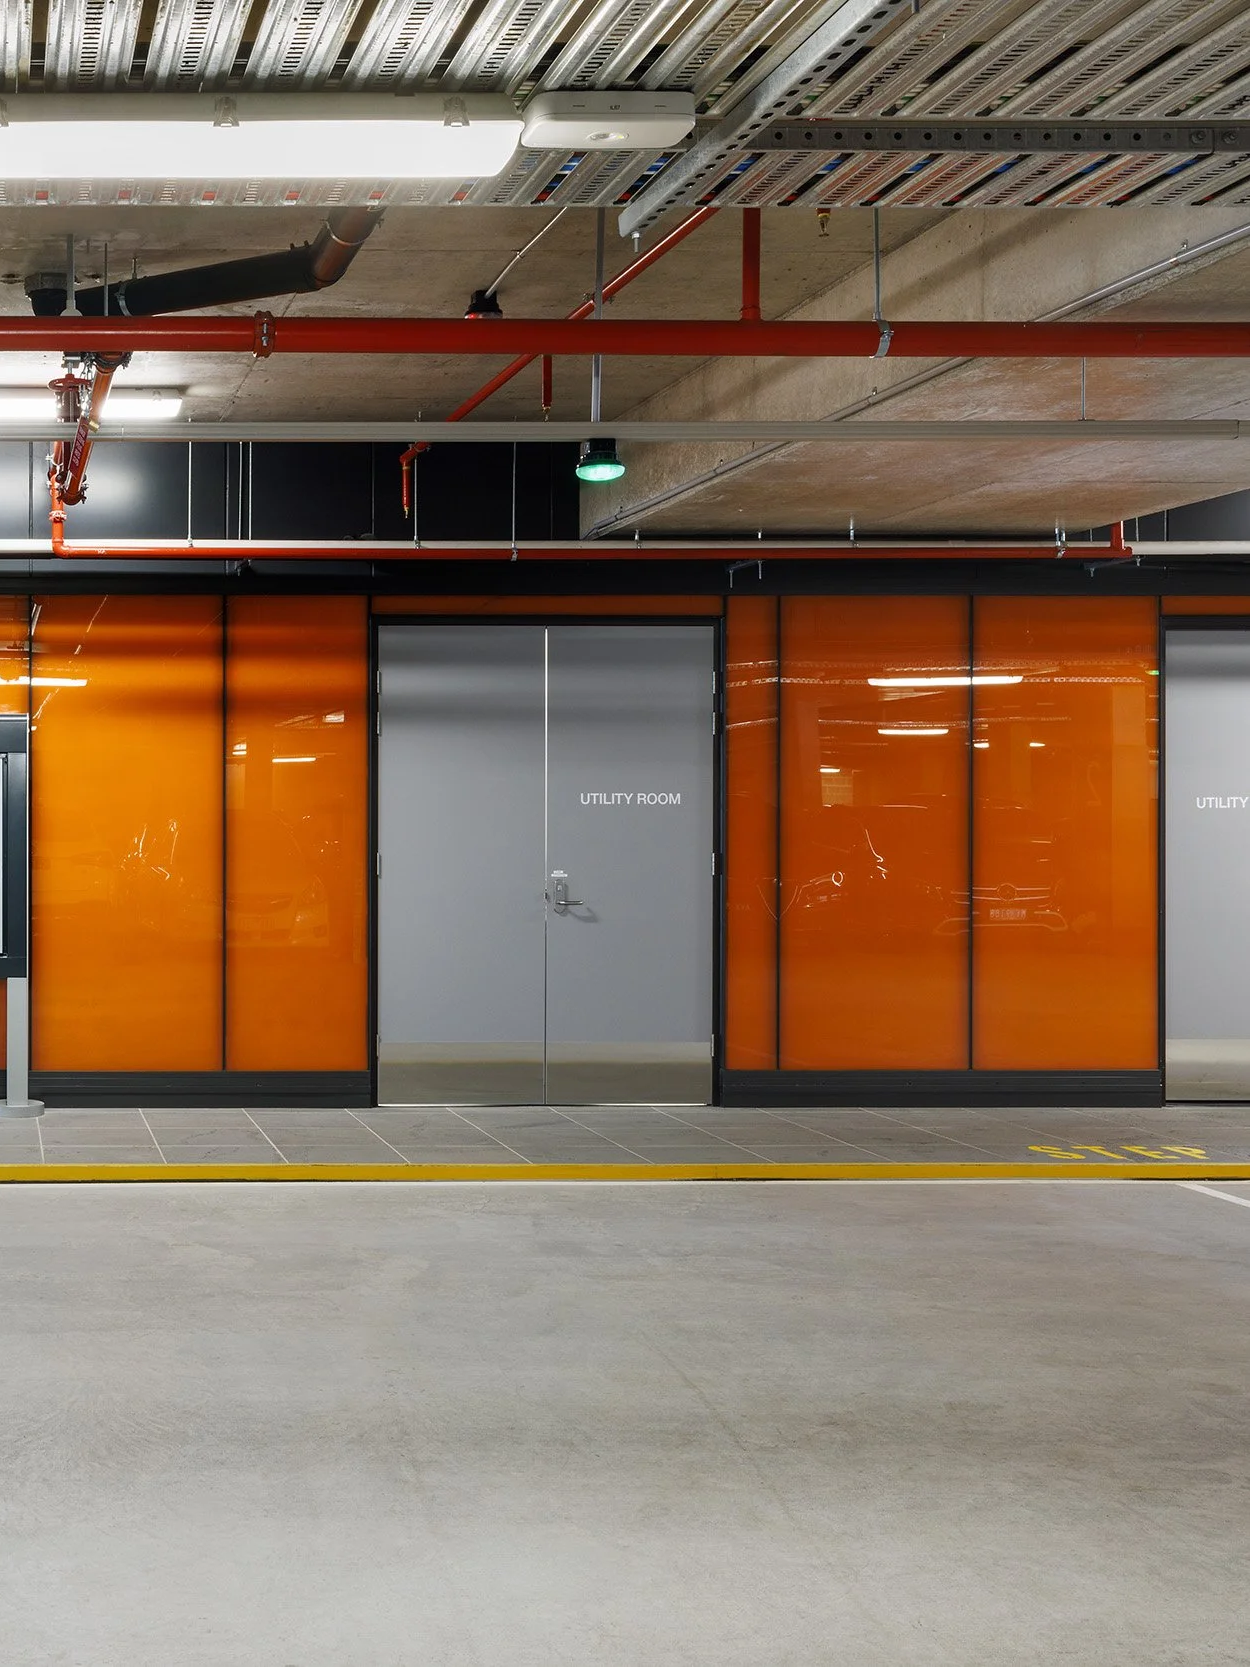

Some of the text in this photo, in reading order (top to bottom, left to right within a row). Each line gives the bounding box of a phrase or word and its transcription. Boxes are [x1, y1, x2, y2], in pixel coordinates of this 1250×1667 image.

[580, 793, 681, 805] UTILITY ROOM
[1196, 796, 1249, 809] UTILITY
[1028, 1145, 1210, 1160] STEP
